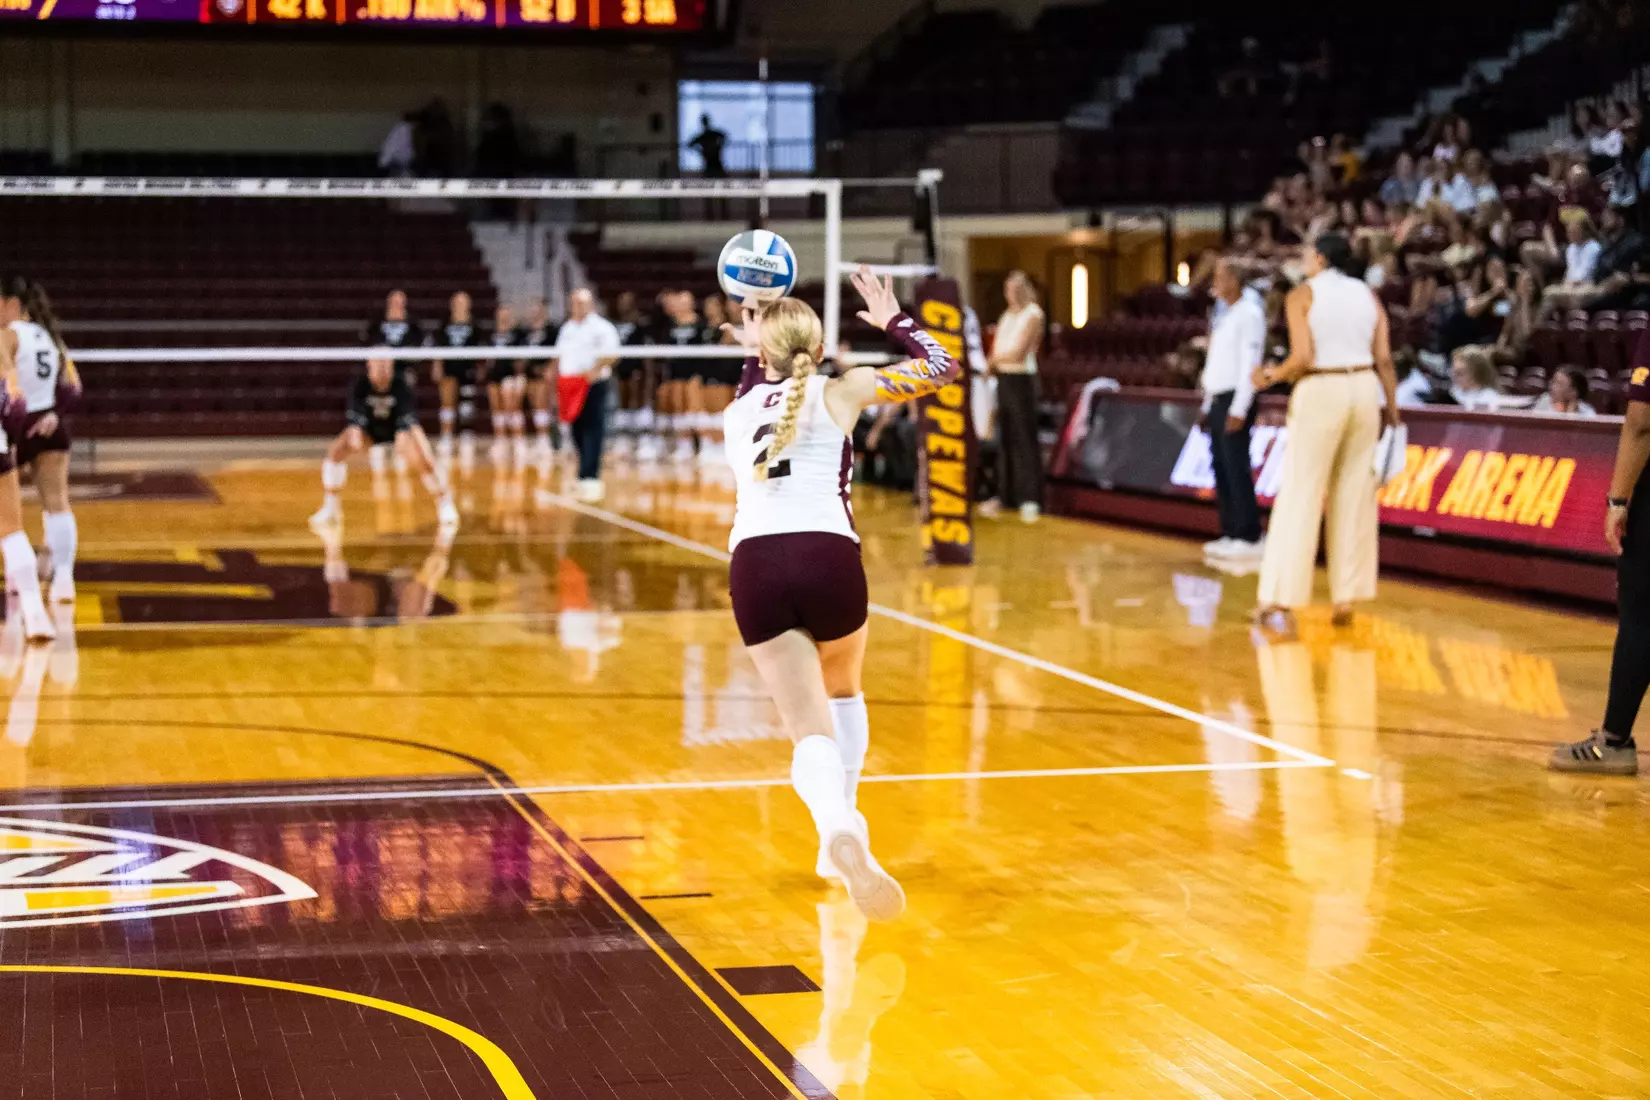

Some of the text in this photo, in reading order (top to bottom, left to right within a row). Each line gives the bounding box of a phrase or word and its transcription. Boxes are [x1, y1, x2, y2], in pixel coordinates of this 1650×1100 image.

[737, 255, 779, 271] molten
[36, 350, 52, 379] 5
[763, 391, 783, 408] C
[921, 300, 970, 545] CHPPEWAS
[752, 422, 791, 480] 2
[1437, 449, 1578, 529] ARENA
